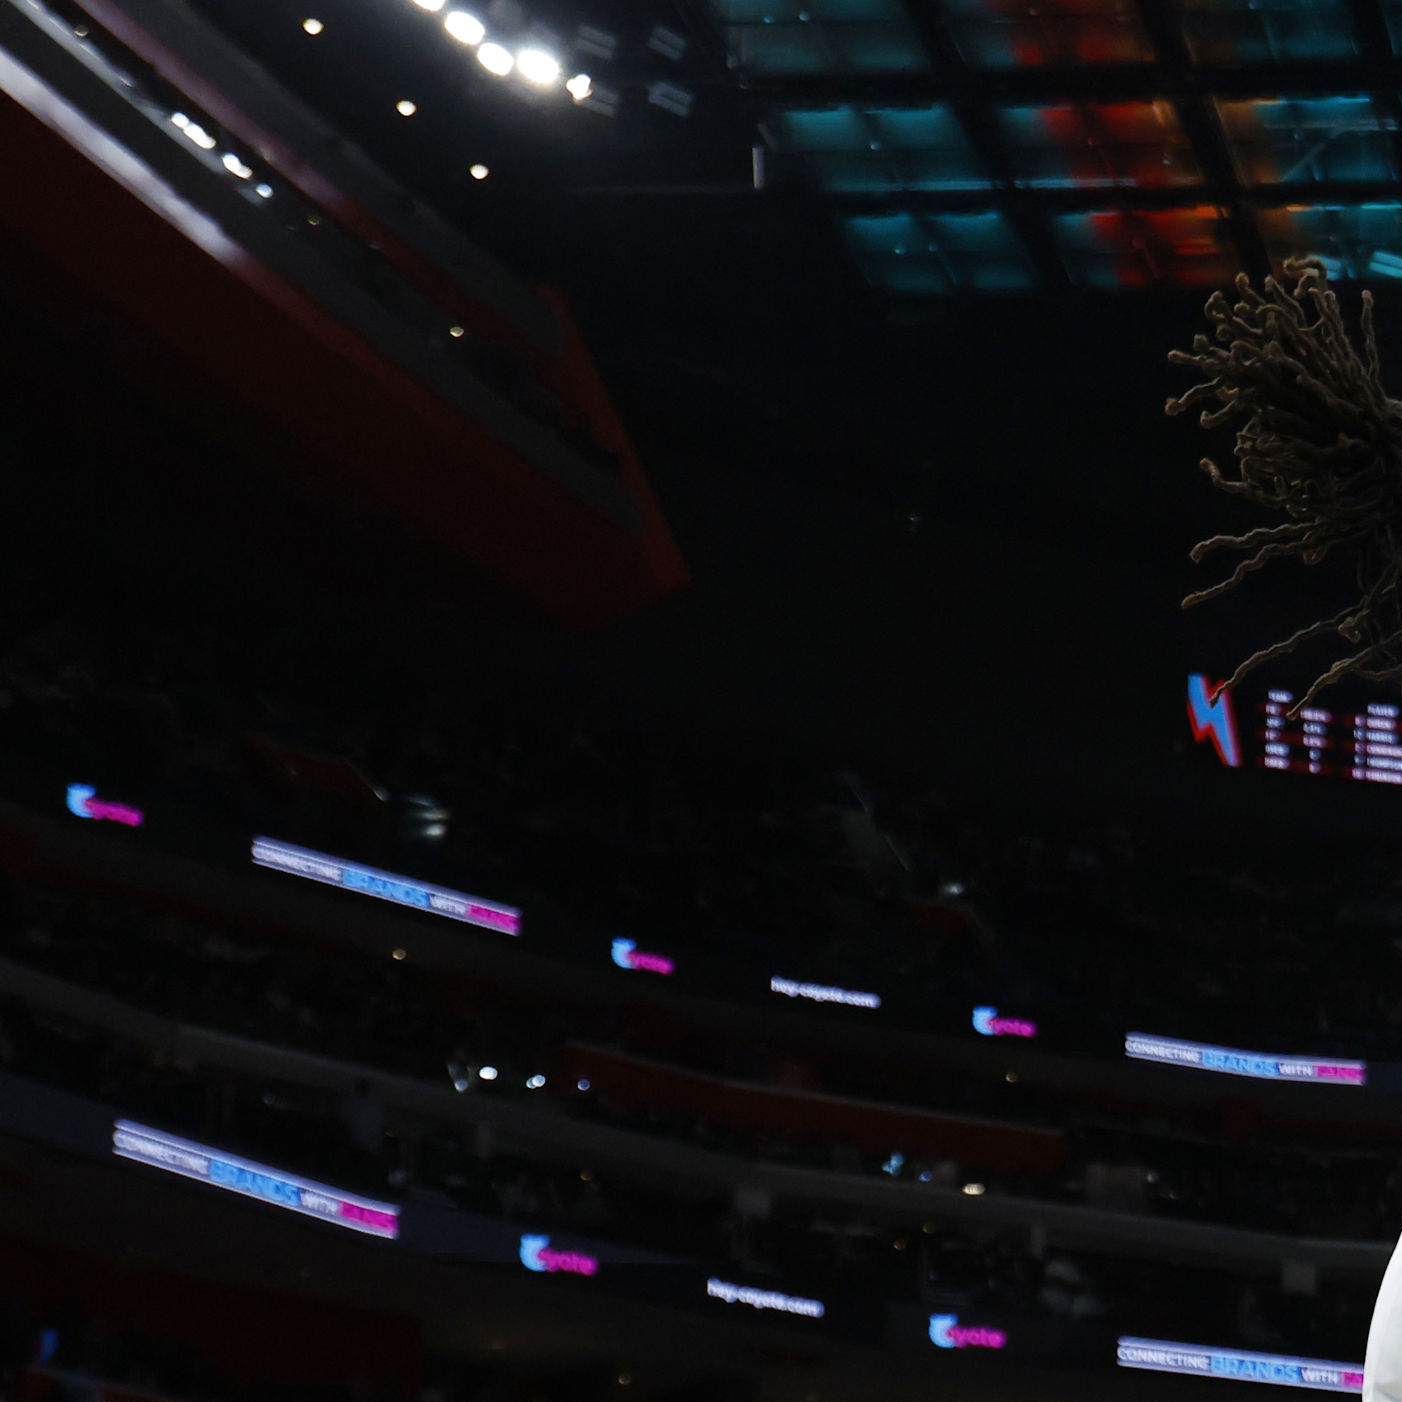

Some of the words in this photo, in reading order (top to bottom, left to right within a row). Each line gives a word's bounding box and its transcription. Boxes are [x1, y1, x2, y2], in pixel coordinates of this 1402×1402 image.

[1117, 1345, 1209, 1369] CONNECTING
[1211, 1353, 1298, 1383] BRANDS
[1301, 1367, 1337, 1384] WITH
